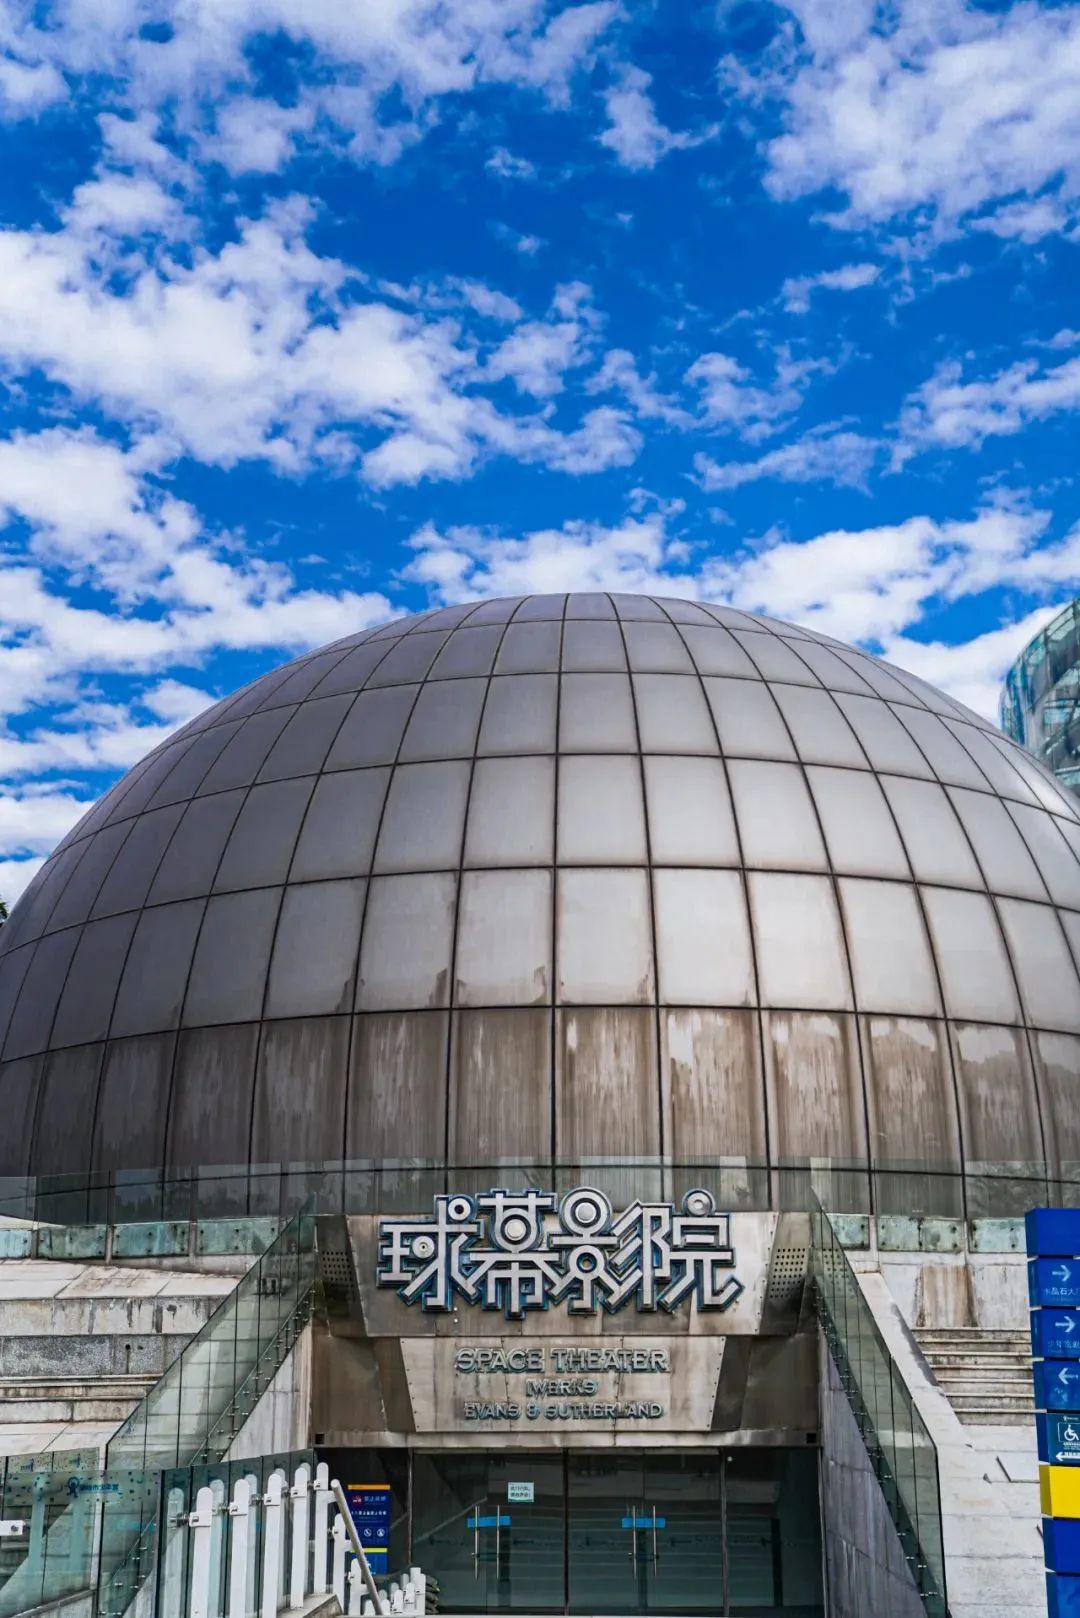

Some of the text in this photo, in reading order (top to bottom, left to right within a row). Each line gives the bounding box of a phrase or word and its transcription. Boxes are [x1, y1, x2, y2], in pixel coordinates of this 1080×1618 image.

[377, 1187, 745, 1320] 球幕影院
[455, 1348, 671, 1373] SPACE THEATER
[526, 1378, 598, 1397] IWERKS
[464, 1402, 664, 1419] EVANS & SUTHERLAND
